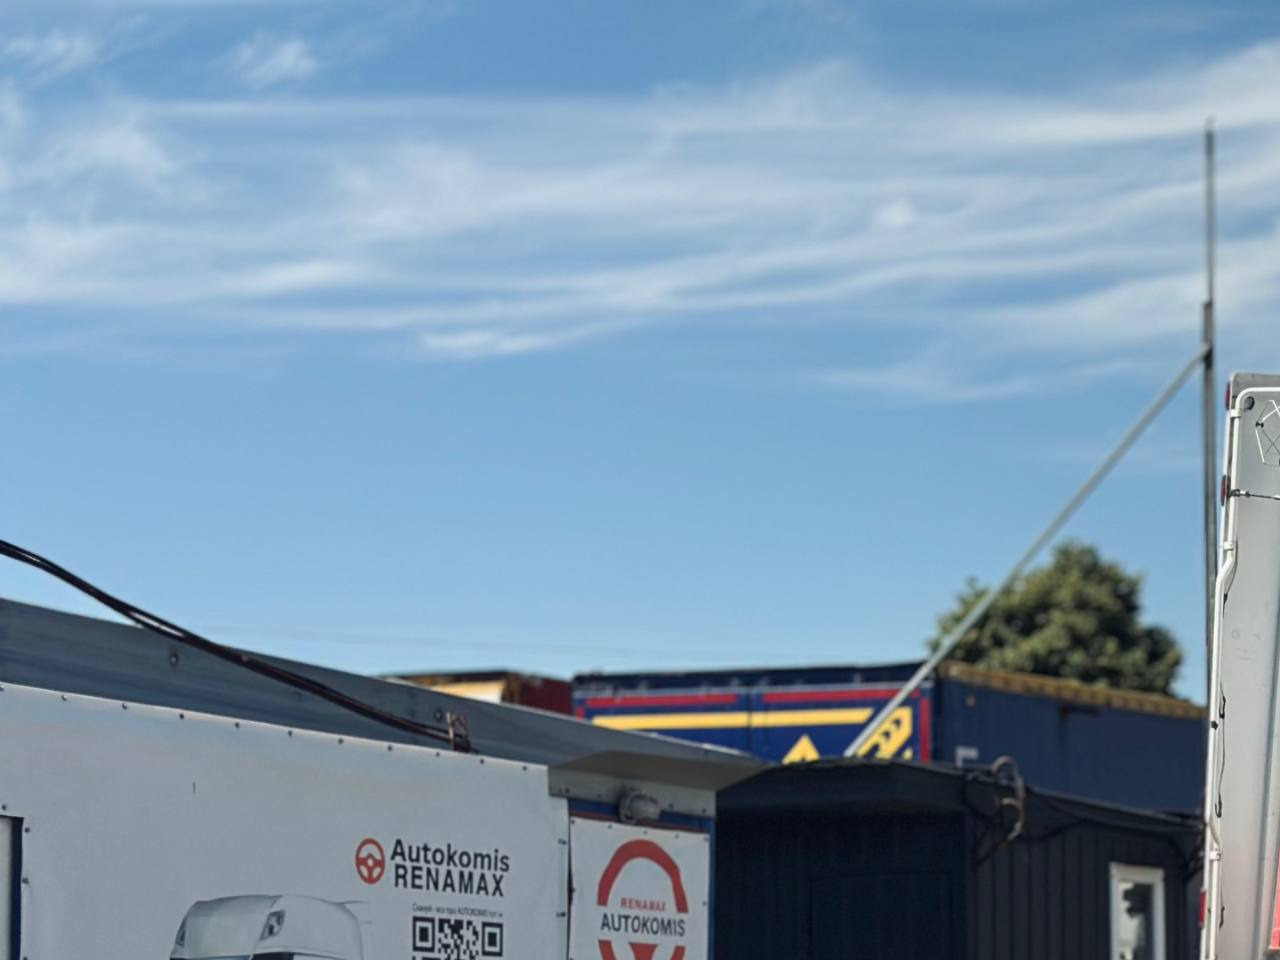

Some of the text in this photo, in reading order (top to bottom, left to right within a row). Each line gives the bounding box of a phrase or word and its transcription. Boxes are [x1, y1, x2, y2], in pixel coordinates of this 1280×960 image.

[390, 838, 511, 873] Autokomis
[394, 863, 505, 898] RENAMAX
[620, 897, 667, 912] RENAMAX
[600, 912, 686, 938] AUTOKOMIS
